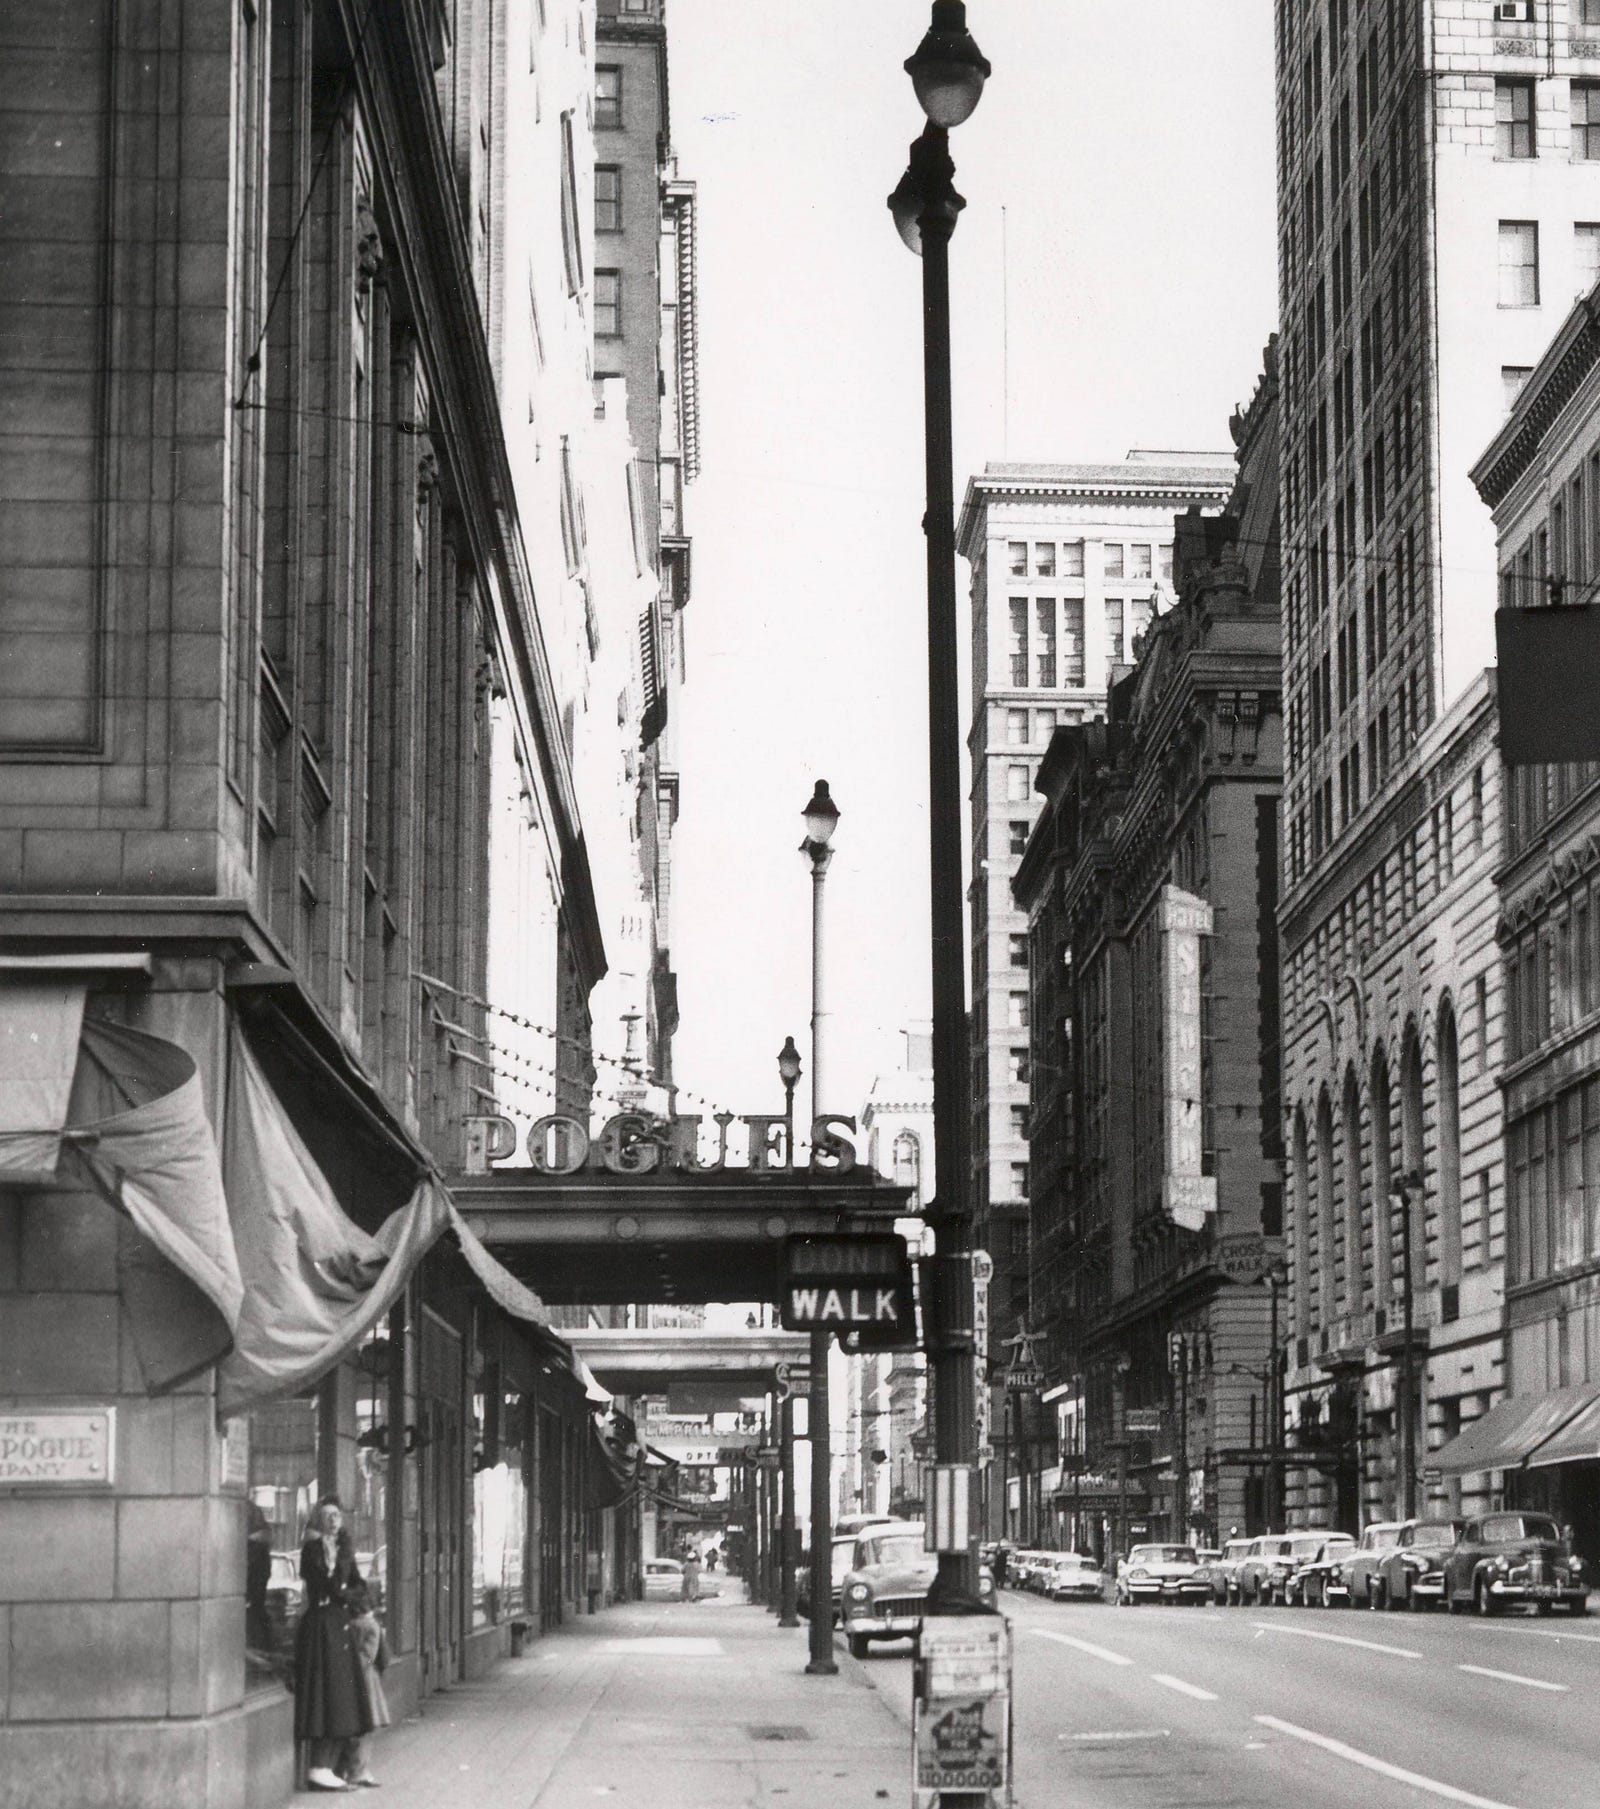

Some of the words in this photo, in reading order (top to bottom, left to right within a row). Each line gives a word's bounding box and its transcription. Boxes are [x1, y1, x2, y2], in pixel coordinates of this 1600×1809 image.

[462, 1113, 857, 1175] POGUES
[791, 1289, 897, 1321] WALK
[5, 1421, 37, 1434] HE
[1, 1437, 94, 1460] POGUE
